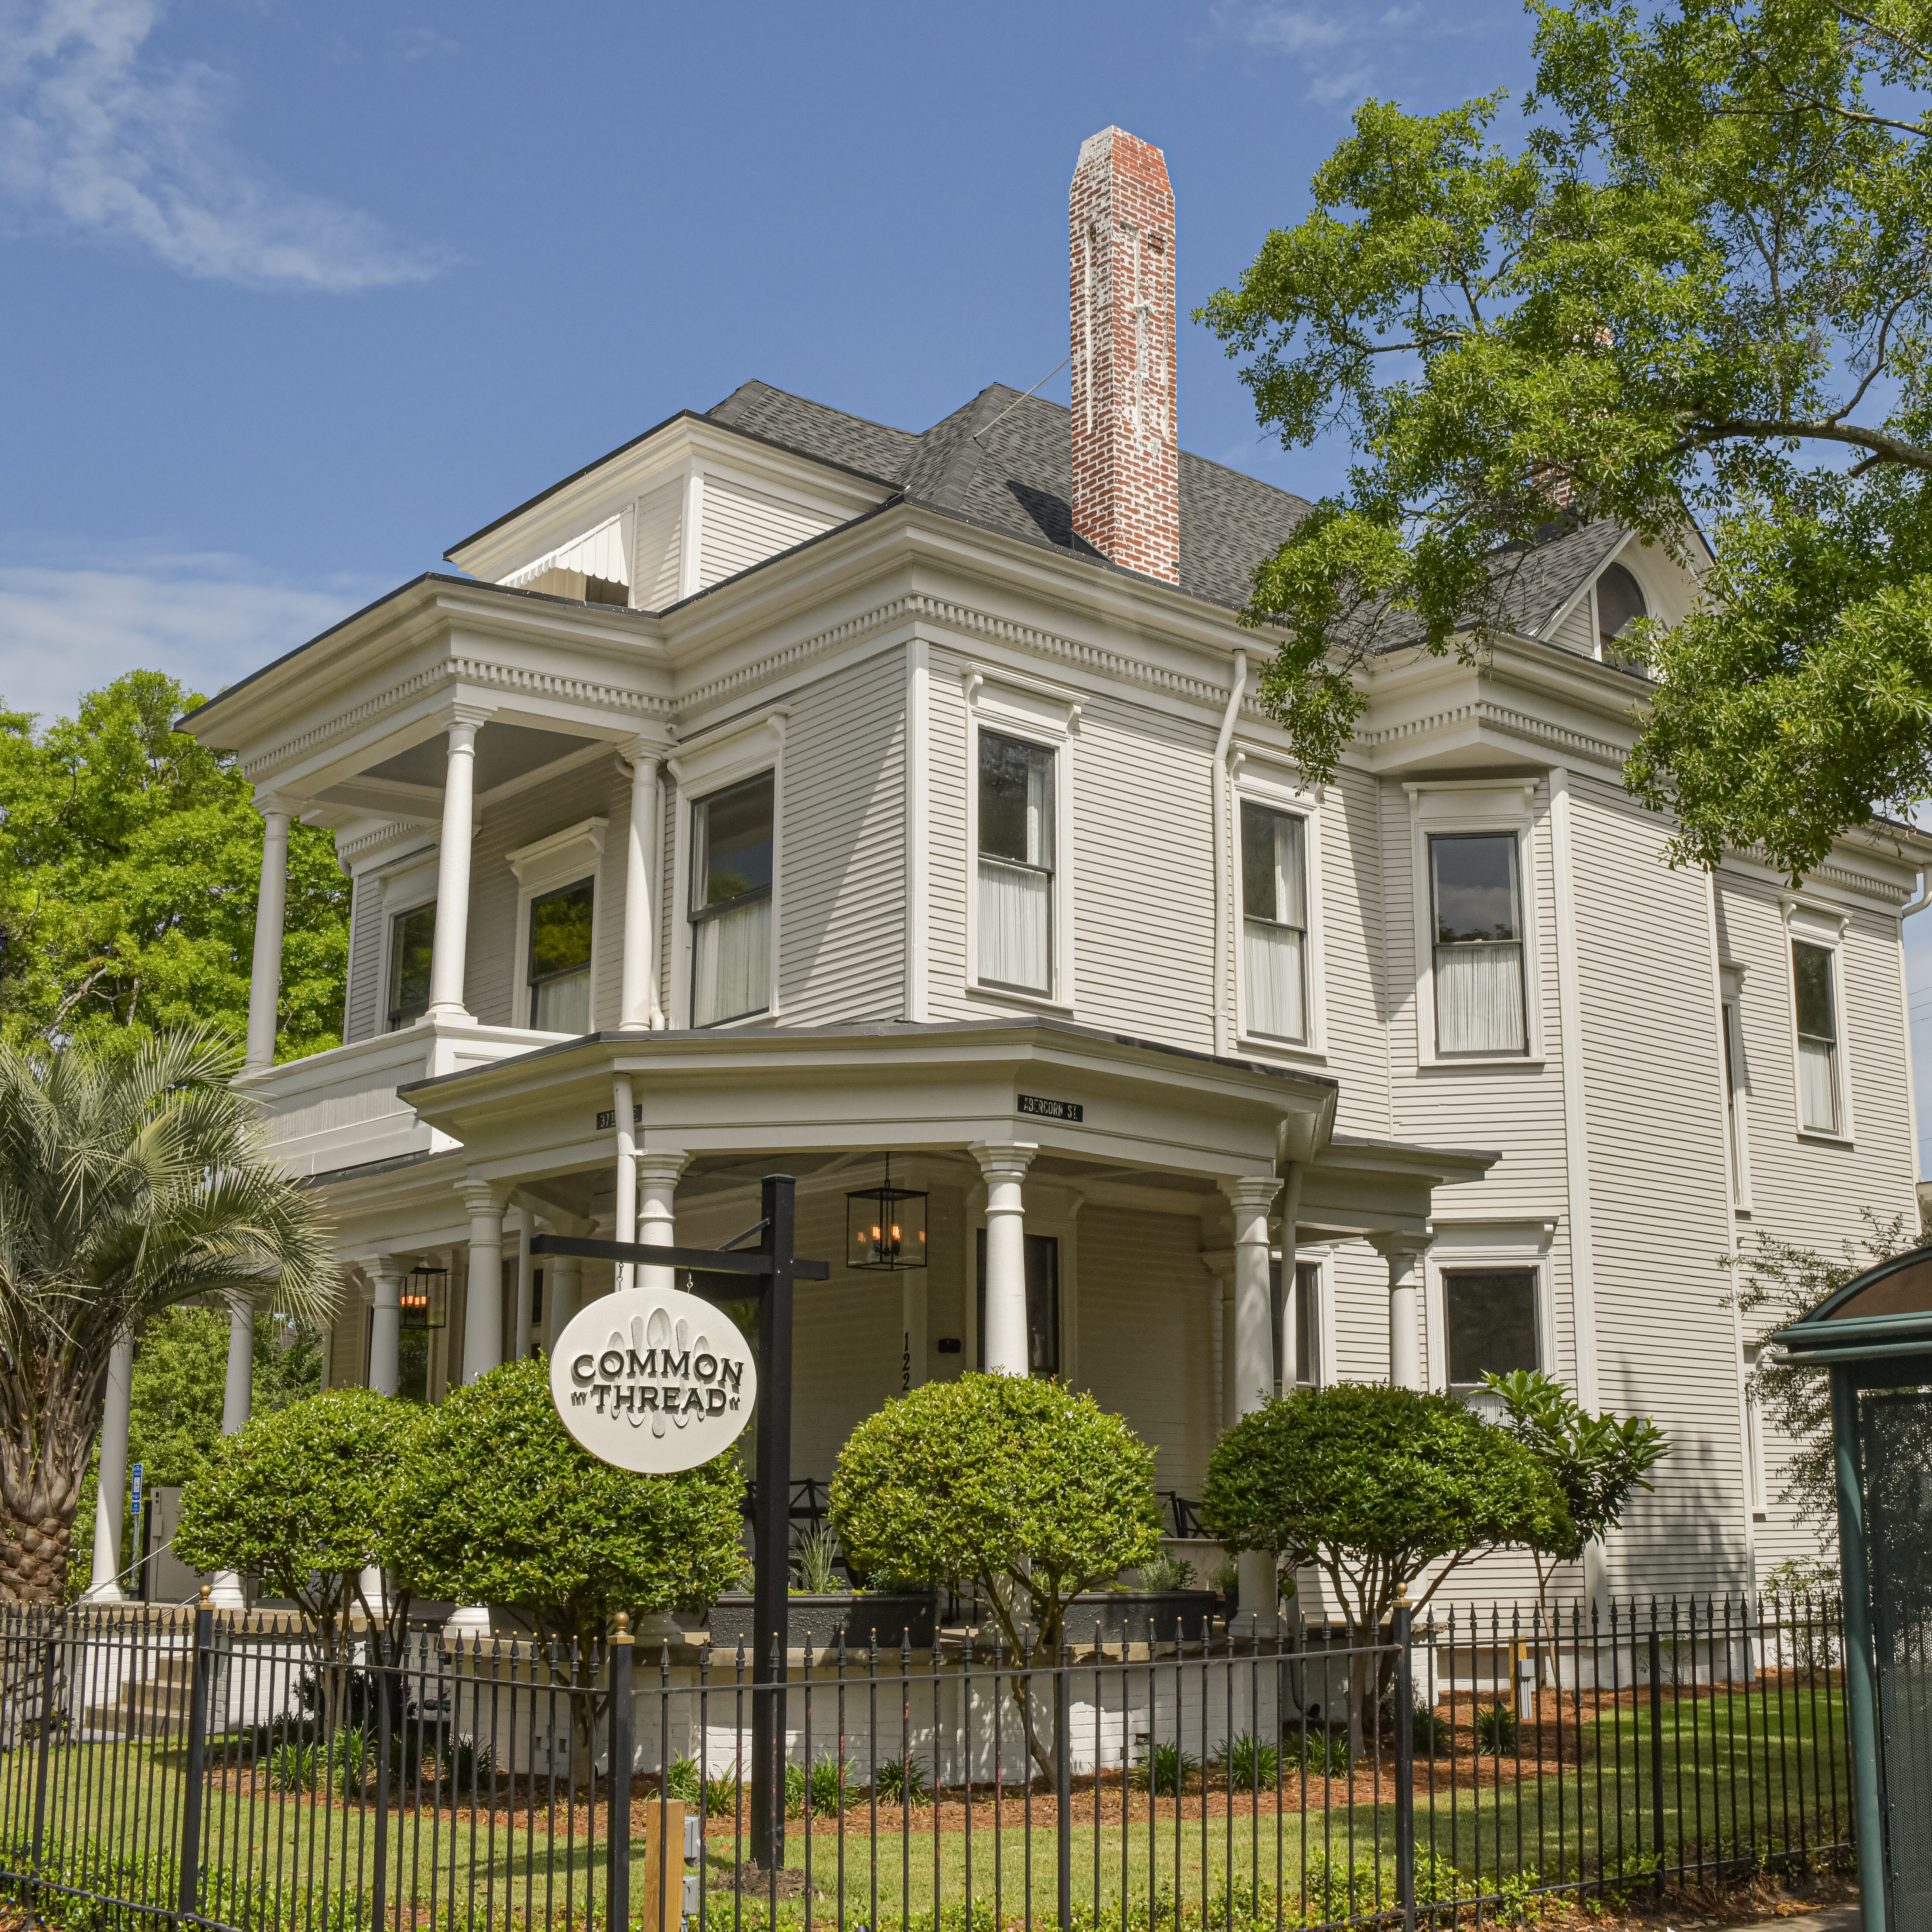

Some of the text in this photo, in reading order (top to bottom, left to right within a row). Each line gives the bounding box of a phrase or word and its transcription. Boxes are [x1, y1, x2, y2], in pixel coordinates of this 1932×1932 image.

[1024, 1097, 1063, 1117] ABERCORN
[600, 1112, 616, 1127] 37T
[574, 1349, 744, 1386] COMMON
[593, 1384, 727, 1412] THREAD
